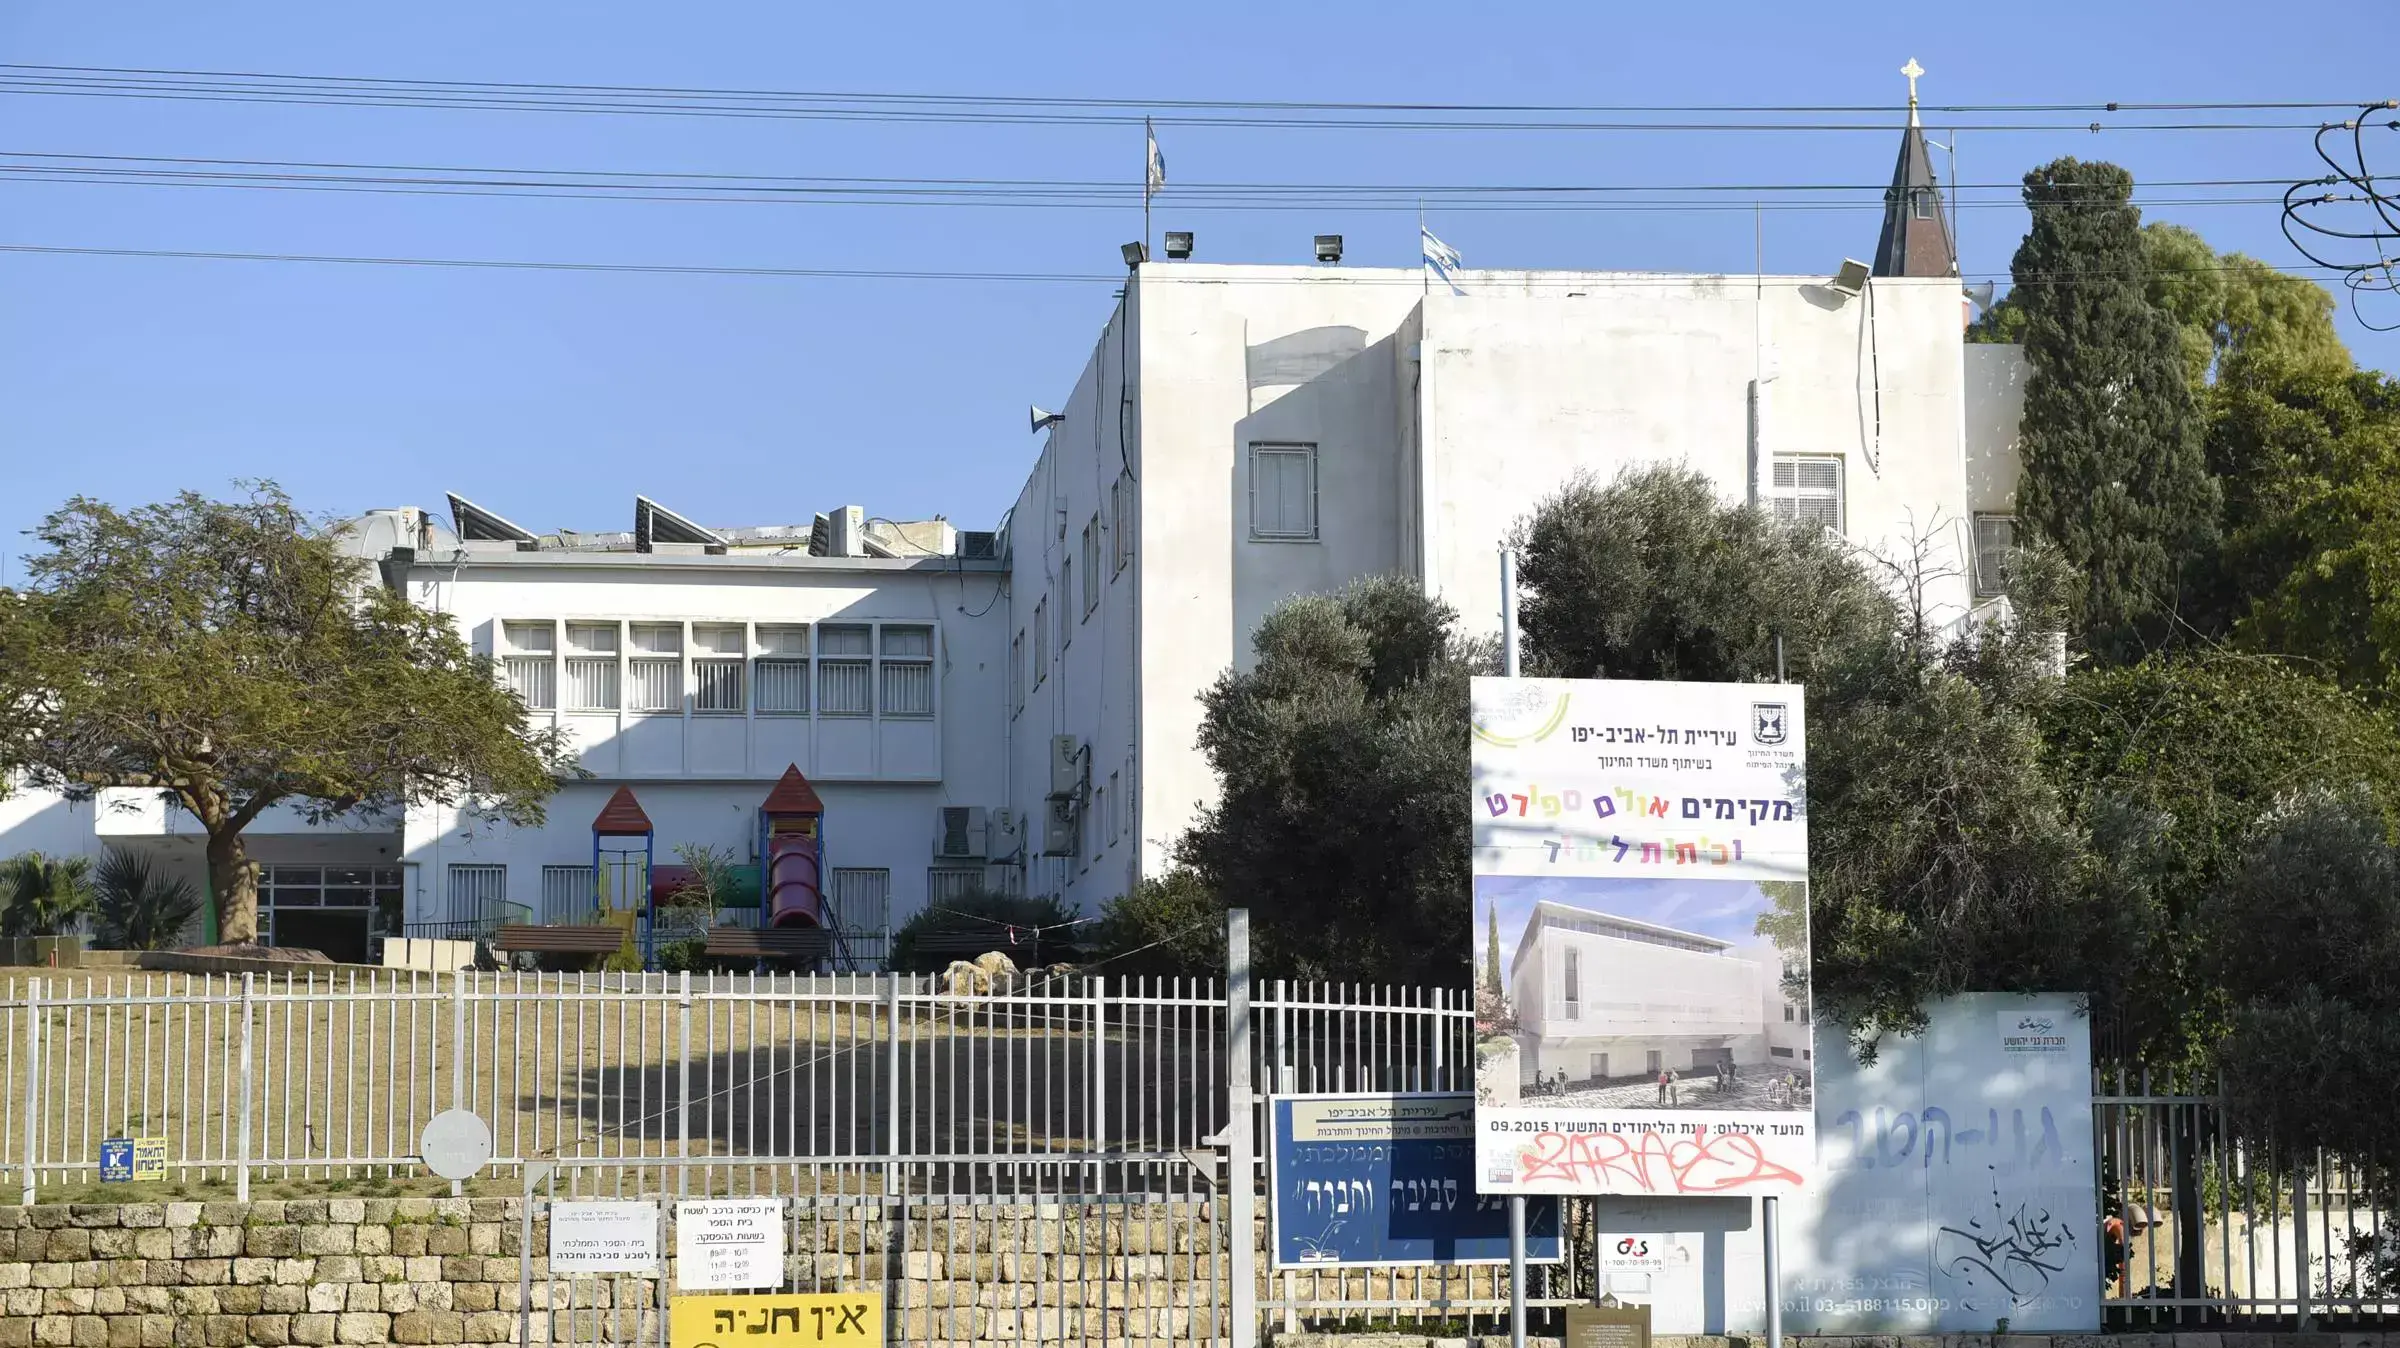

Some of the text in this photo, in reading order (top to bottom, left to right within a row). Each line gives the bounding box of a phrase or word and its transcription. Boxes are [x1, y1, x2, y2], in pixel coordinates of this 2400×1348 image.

[1571, 725, 1737, 746] עיריית תל-אביב-יפו
[1747, 750, 1794, 758] משרד החינוך
[1597, 756, 1713, 772] בשיתוף משרד החינוך
[1486, 784, 1793, 826] מקימים אולם ספורט
[1641, 836, 1742, 866] וכיתות
[1402, 1106, 1439, 1117] עיריית
[1317, 1127, 1353, 1137] והתרבות
[1355, 1127, 1383, 1137] החינוך
[1490, 1120, 1549, 1132] 09.2015
[1612, 1120, 1675, 1135] הלימודים
[1713, 1122, 1765, 1136] איכלוס:
[1770, 1124, 1804, 1136] מועד
[1391, 1177, 1458, 1214] סביבה
[683, 1205, 776, 1216] אין כניסה ברכב לשטח
[708, 1219, 753, 1227] בית הספר
[562, 1238, 645, 1248] בית הספר הממלכתי
[696, 1233, 733, 1243] ההפסקה
[556, 1250, 651, 1260] לטבע סביבה וחברה
[714, 1304, 868, 1341] אין חניה
